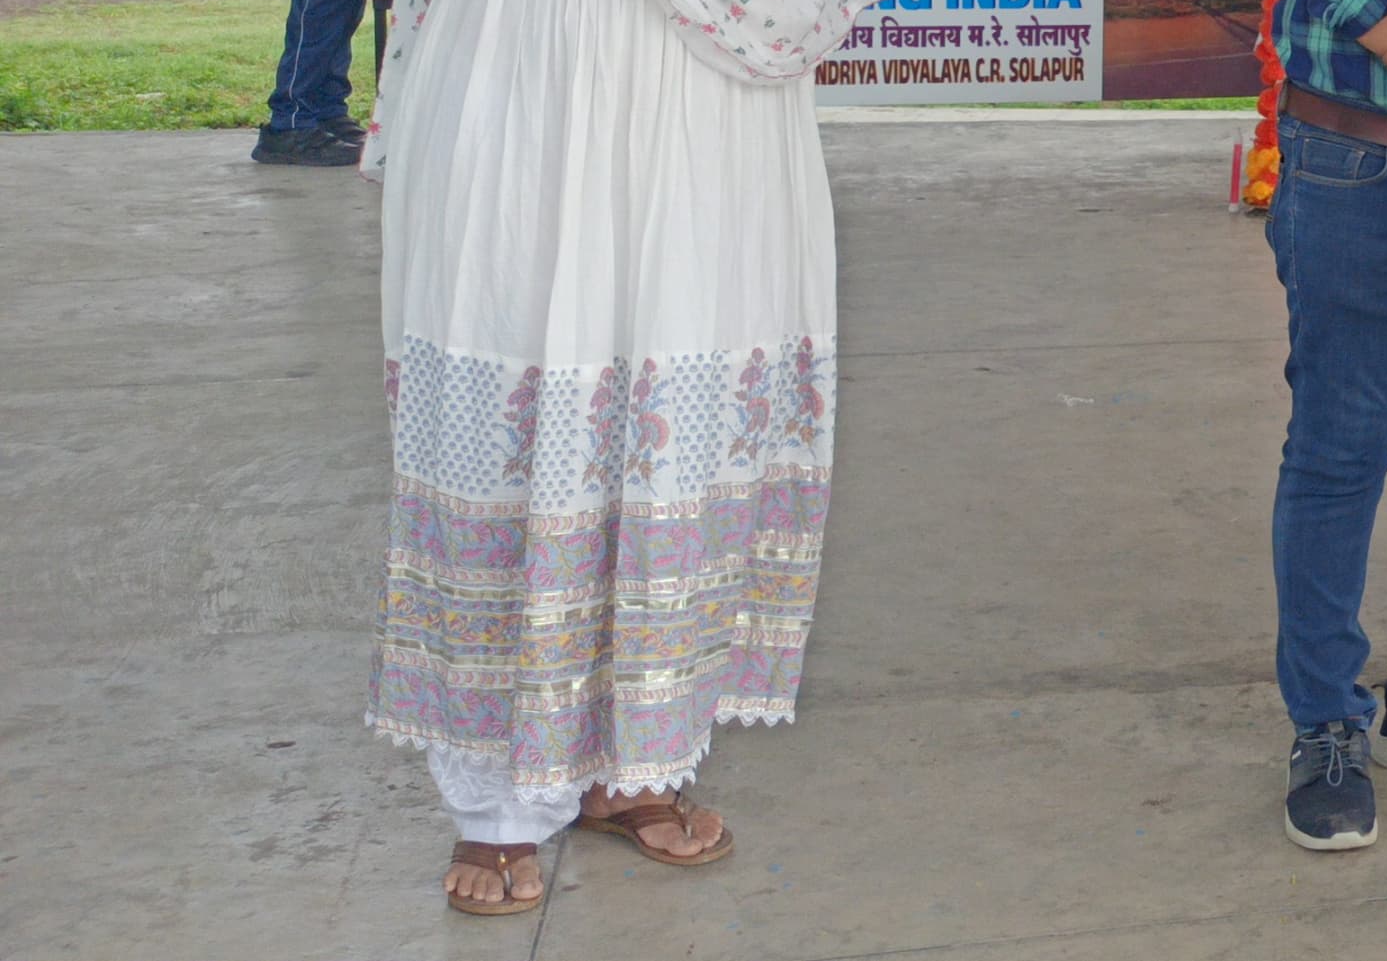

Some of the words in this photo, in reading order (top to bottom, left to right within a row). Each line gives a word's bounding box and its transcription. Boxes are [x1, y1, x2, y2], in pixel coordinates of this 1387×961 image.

[880, 16, 962, 49] विद्यालय
[1016, 16, 1092, 56] सोलापुर
[815, 59, 878, 86] NDRIYA
[882, 58, 972, 85] VIDYALAYA
[975, 57, 1004, 84] C.R.
[1009, 56, 1085, 83] SOLAPUR
